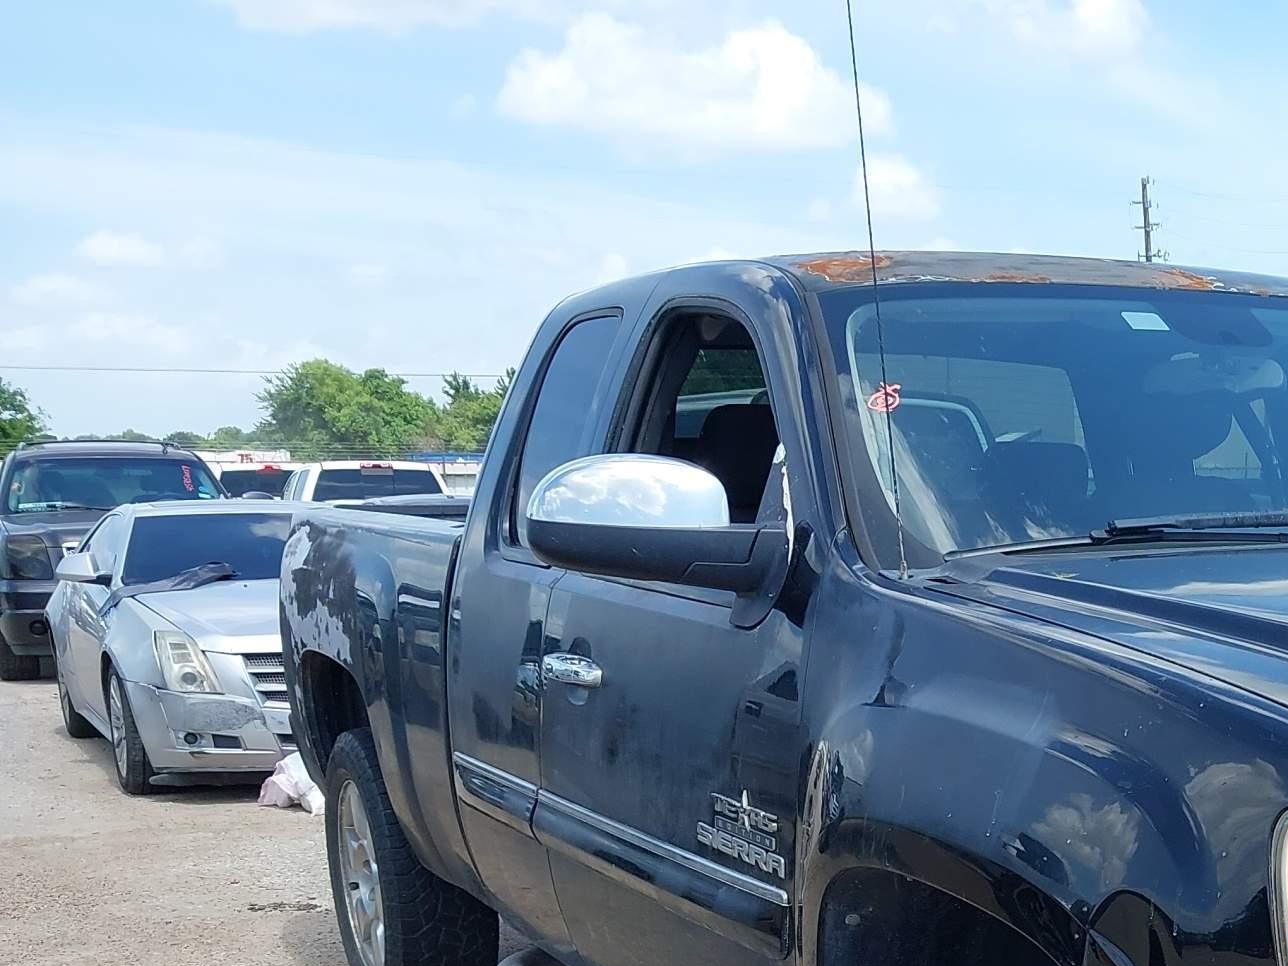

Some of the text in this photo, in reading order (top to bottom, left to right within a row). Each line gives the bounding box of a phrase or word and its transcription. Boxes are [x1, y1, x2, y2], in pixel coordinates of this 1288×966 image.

[710, 790, 779, 833] TEXAS
[717, 818, 772, 848] EDITION
[697, 821, 786, 879] SIERRA
